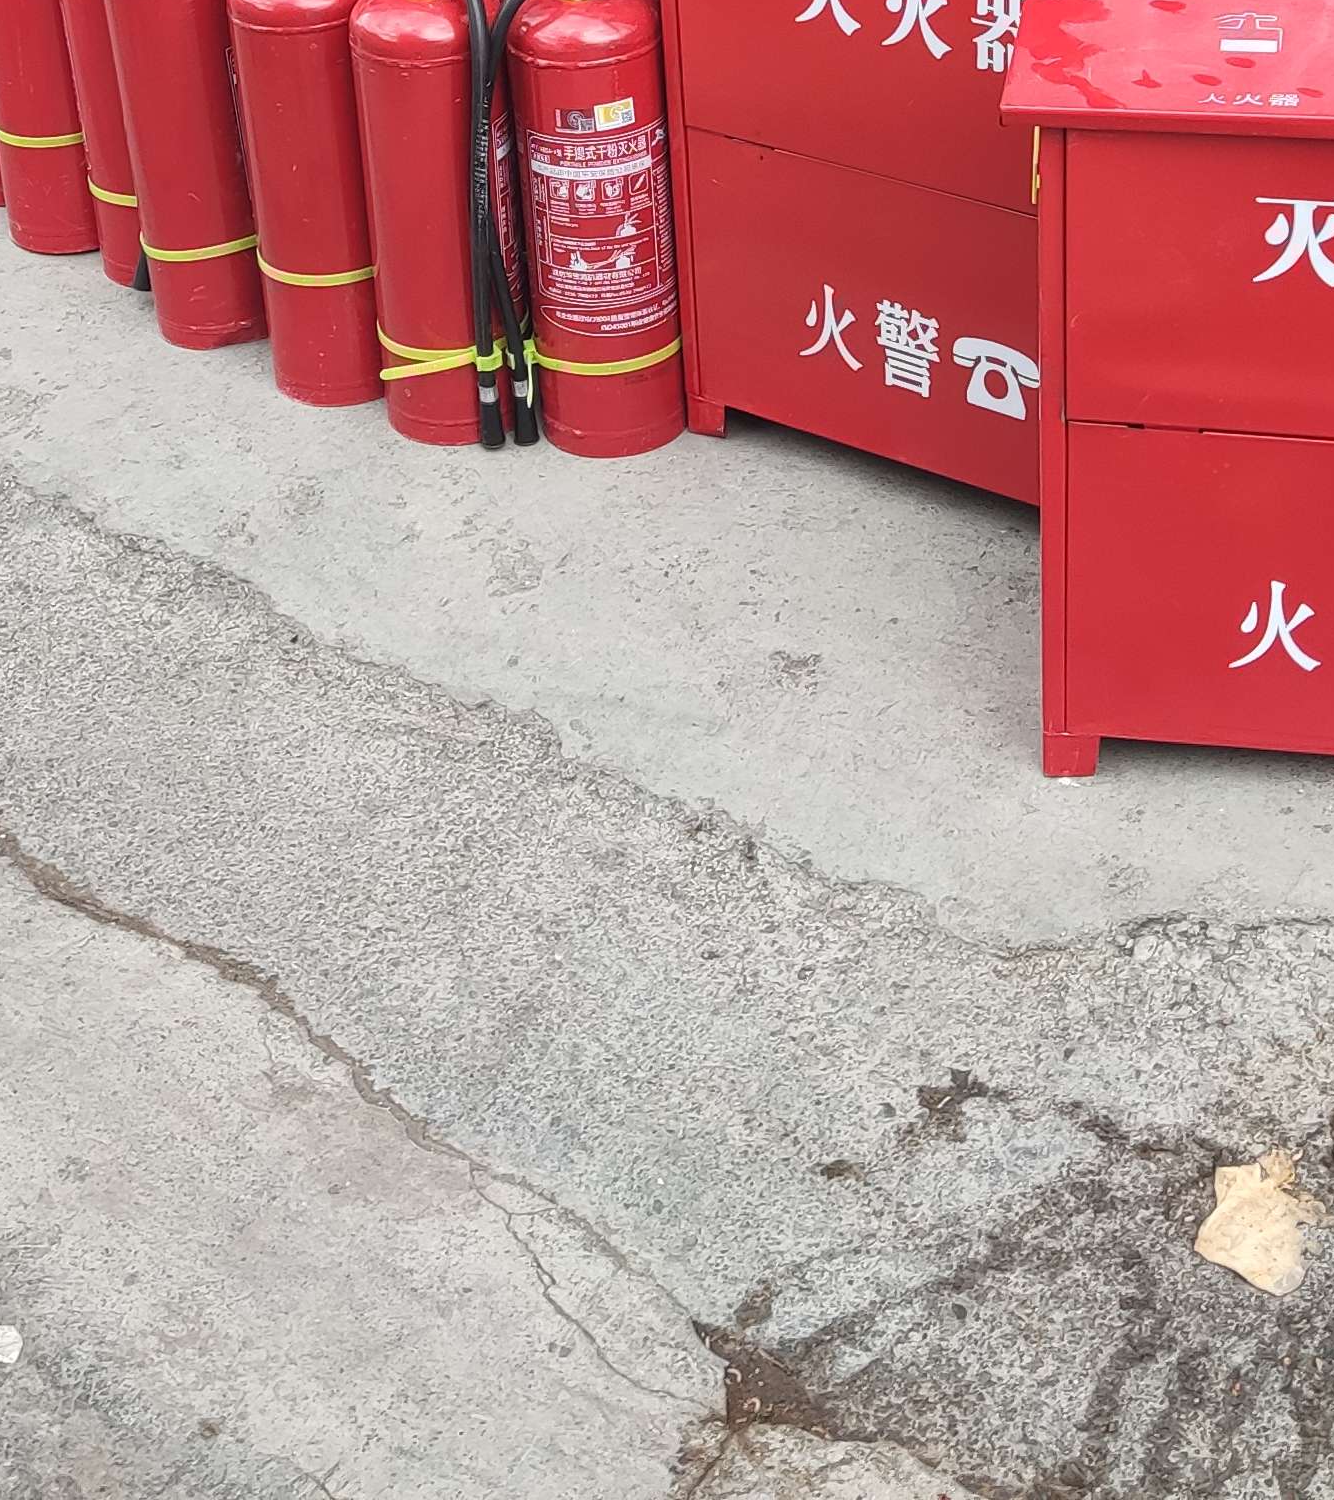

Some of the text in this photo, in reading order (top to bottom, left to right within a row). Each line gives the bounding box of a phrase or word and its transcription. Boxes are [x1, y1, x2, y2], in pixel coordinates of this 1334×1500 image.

[563, 134, 648, 162] 手提式干粉灭火器
[798, 283, 942, 398] 火警
